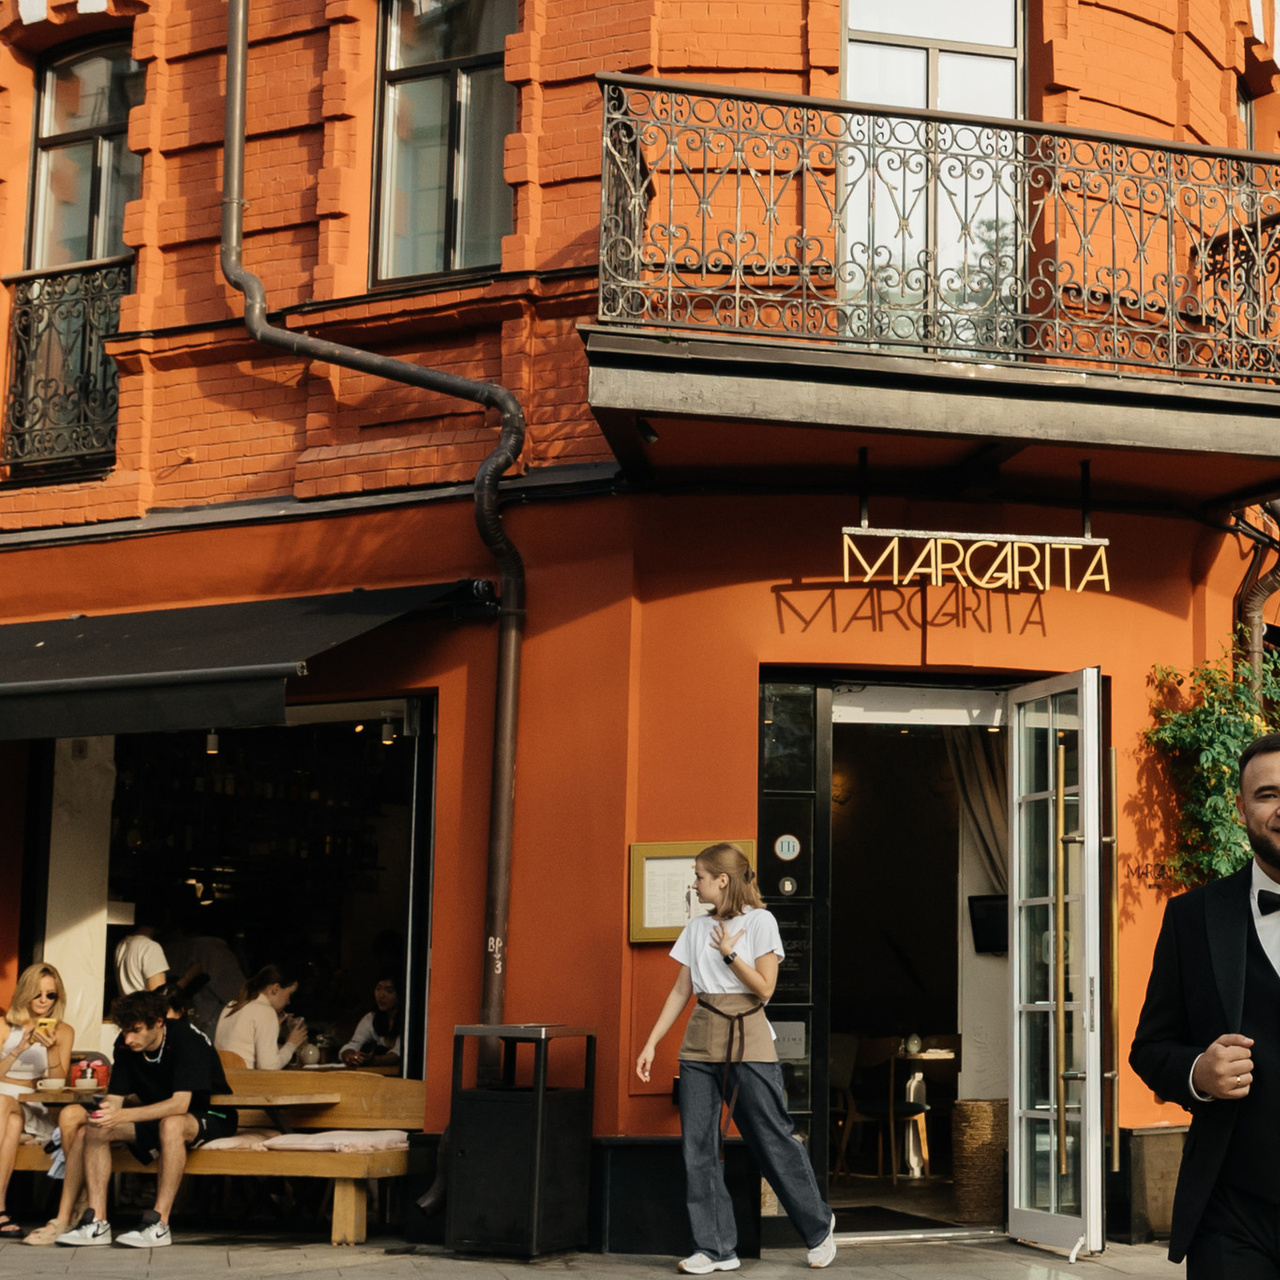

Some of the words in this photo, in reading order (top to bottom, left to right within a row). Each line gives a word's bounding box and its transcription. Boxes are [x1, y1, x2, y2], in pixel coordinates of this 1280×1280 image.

[842, 533, 1111, 593] MARGARITA
[775, 587, 1046, 637] MARGARITA
[1126, 862, 1172, 880] MARGA
